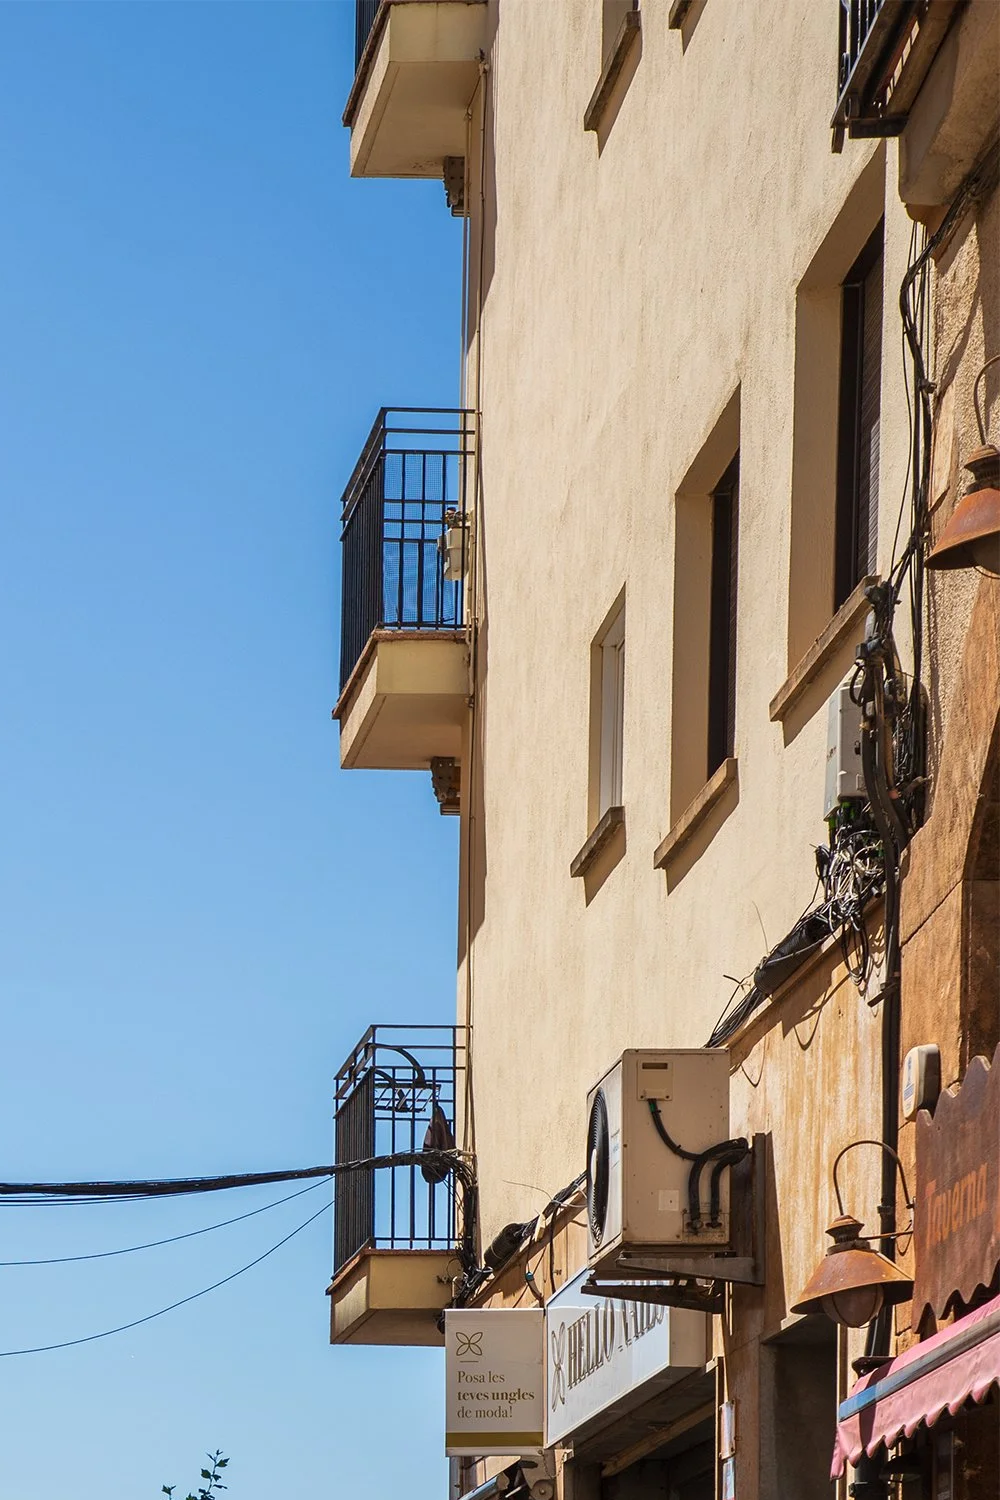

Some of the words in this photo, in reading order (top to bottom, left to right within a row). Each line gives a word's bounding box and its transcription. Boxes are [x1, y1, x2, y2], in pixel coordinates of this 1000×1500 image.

[567, 1297, 616, 1390] HELLO
[457, 1370, 486, 1384] Posa
[488, 1370, 506, 1384] les
[457, 1391, 490, 1401] teves
[491, 1388, 536, 1404] ungles
[457, 1406, 472, 1418] de
[475, 1405, 513, 1418] moda!
